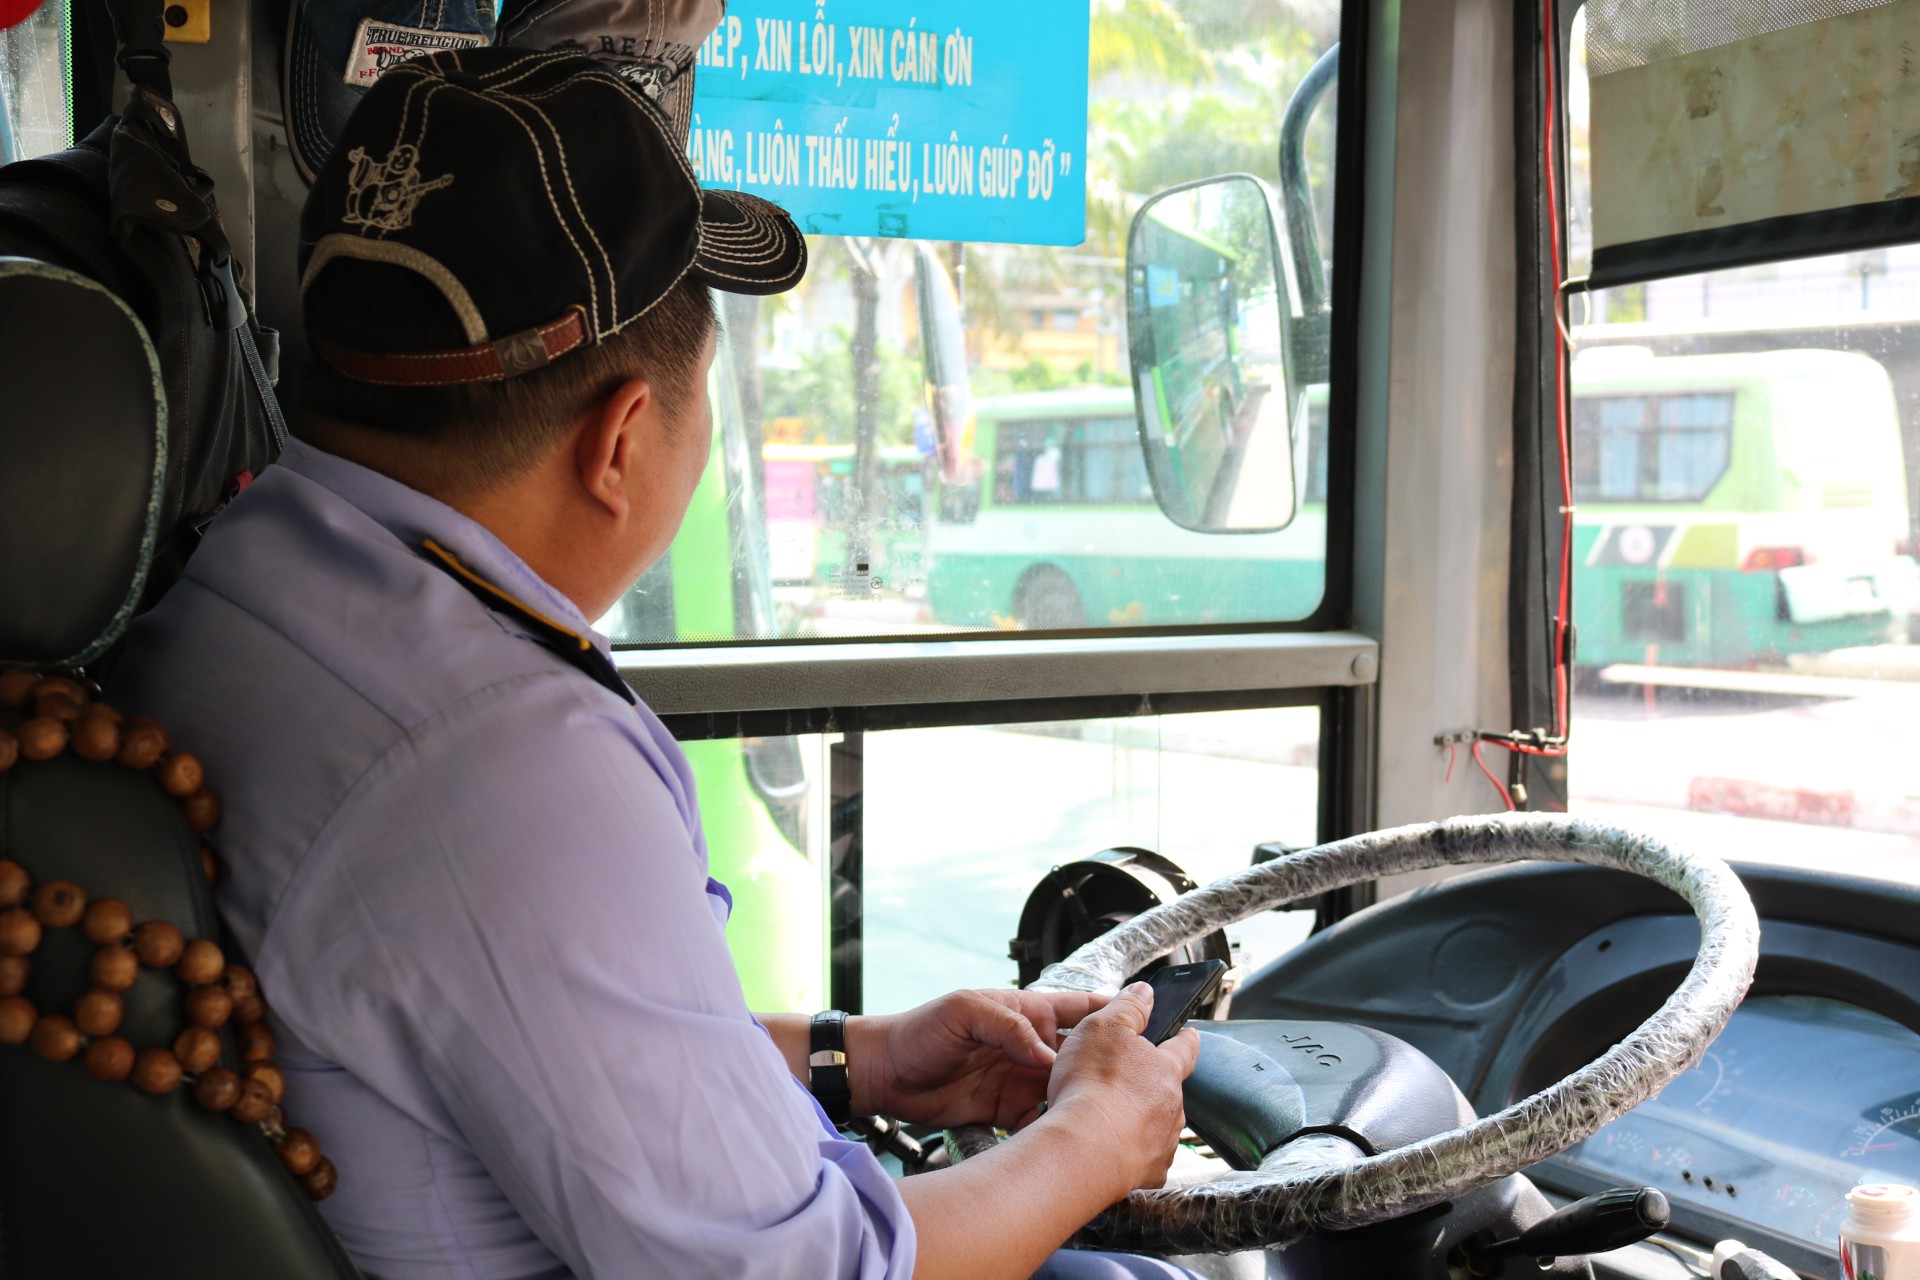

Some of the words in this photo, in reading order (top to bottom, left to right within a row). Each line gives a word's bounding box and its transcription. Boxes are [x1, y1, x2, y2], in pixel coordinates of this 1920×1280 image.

[366, 27, 408, 45] TRUE
[408, 32, 479, 50] RELIGION
[755, 17, 792, 72] XIN
[848, 25, 884, 79] XIN
[891, 16, 937, 83] CÁM
[944, 27, 973, 86] ƠN
[746, 118, 799, 186] LUÔN
[805, 116, 858, 190] THẤU
[865, 112, 918, 203] HIỂU,
[923, 130, 974, 195] LUÔN
[979, 134, 1023, 199] GIÚP
